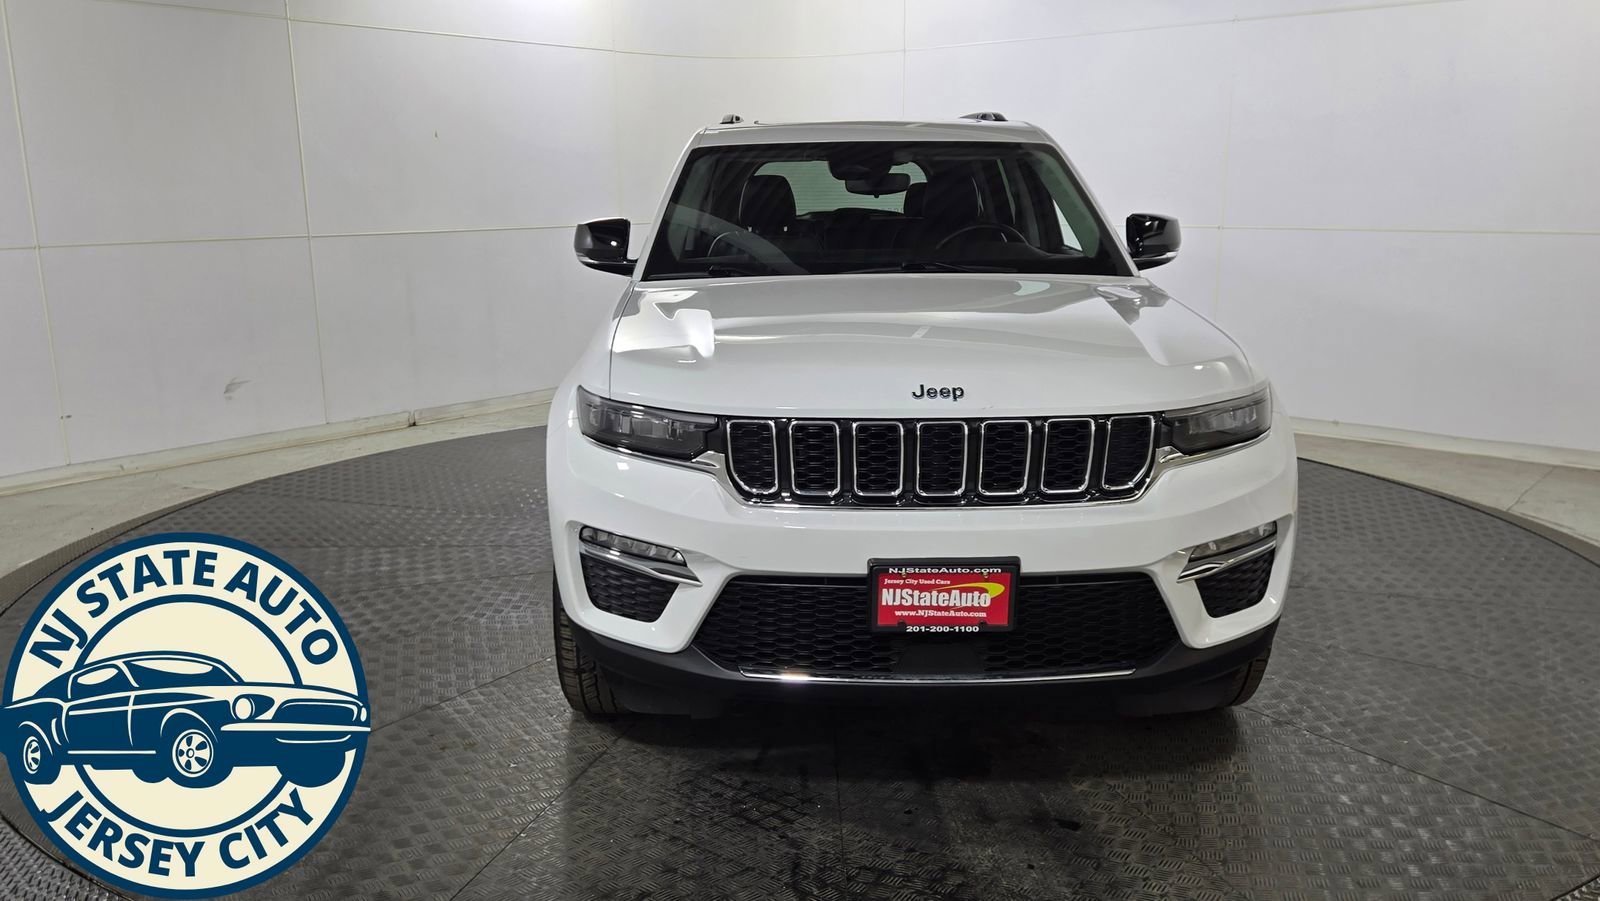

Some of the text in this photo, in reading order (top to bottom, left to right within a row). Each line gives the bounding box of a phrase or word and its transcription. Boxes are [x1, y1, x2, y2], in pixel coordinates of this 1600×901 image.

[912, 383, 964, 401] Jeep
[905, 578, 918, 586] City
[881, 588, 991, 607] NJStateAuto
[894, 609, 987, 618] www.NJStateAuto.com
[906, 625, 980, 633] 201-200-1100
